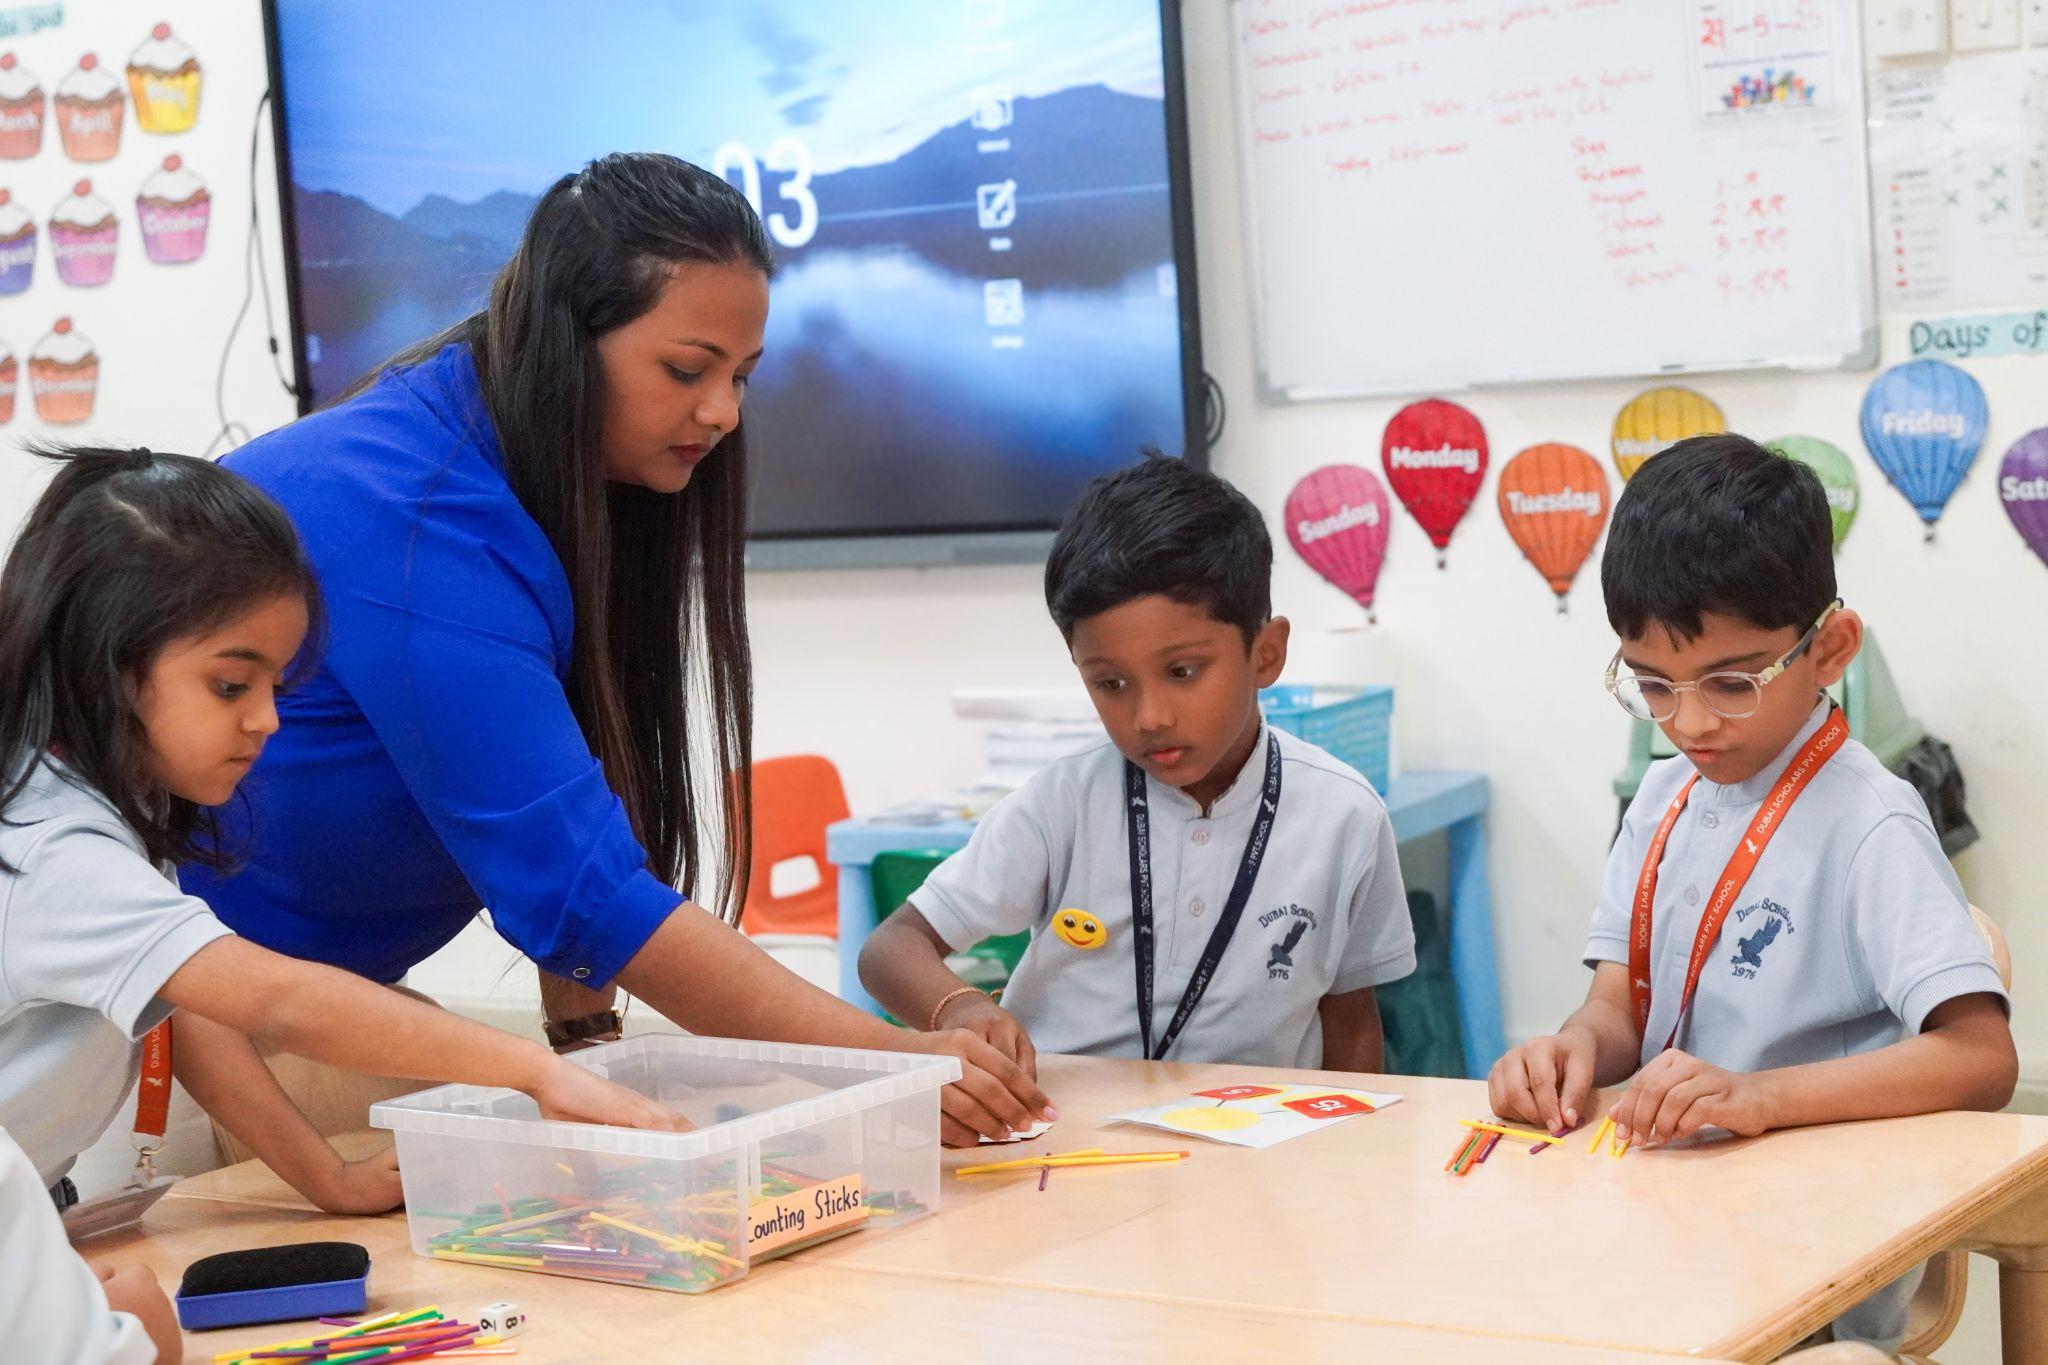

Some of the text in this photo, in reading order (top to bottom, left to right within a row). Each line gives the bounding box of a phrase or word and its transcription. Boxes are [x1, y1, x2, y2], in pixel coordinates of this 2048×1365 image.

[71, 111, 112, 139] April
[1910, 311, 2048, 358] Days of
[1882, 408, 1966, 439] Friday
[1390, 442, 1480, 475] Monday
[1505, 487, 1602, 517] Tuesday
[1297, 501, 1381, 545] Sunday
[1756, 726, 1841, 834] DUBAI SCHOLARS PVT SCHOOL
[1138, 835, 1149, 873] SCHOLARS
[1639, 817, 1672, 949] DUBAI SCHOLARS PVT SCHOOL
[1691, 879, 1736, 978] SCHOLARS PVT SCHOOL
[1269, 968, 1289, 980] 1976
[1732, 966, 1757, 979] 1976
[151, 1043, 161, 1068] DUBAI
[815, 1185, 860, 1220] Sticks
[506, 1316, 519, 1330] 8
